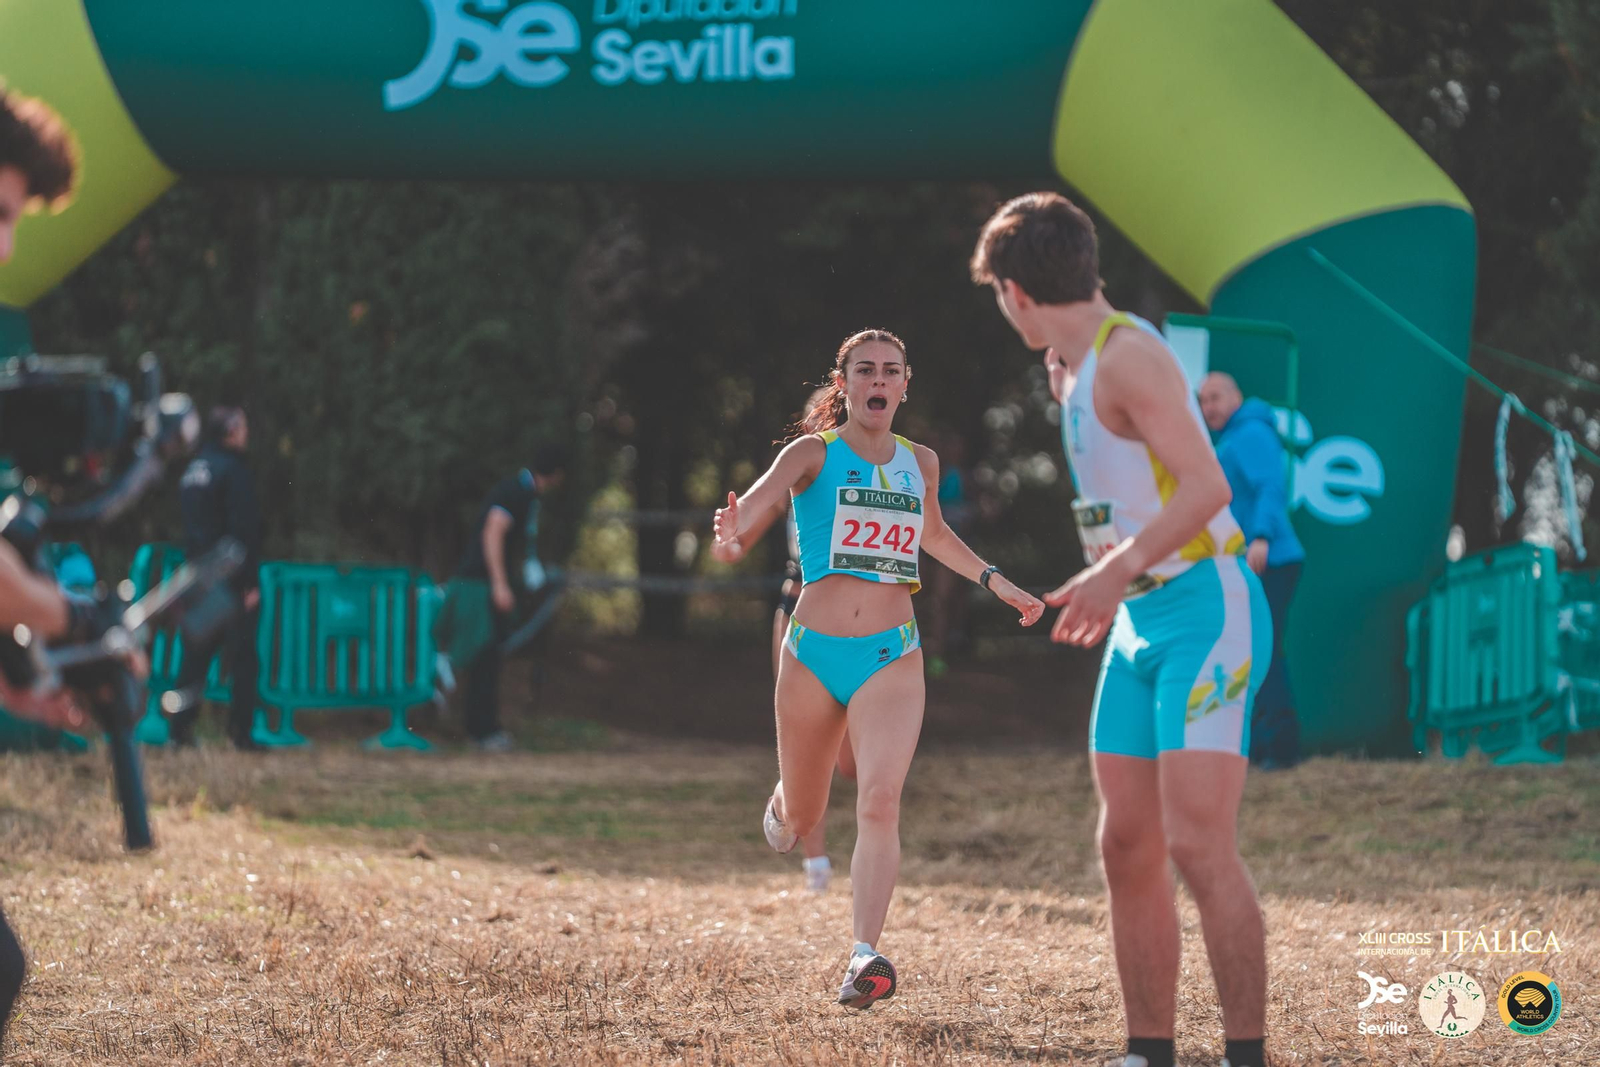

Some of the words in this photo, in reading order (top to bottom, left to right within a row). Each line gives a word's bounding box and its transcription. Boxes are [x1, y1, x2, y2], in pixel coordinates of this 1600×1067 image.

[591, 23, 796, 85] Sevilla
[865, 491, 906, 506] ITÁLICA
[841, 519, 916, 555] 2242
